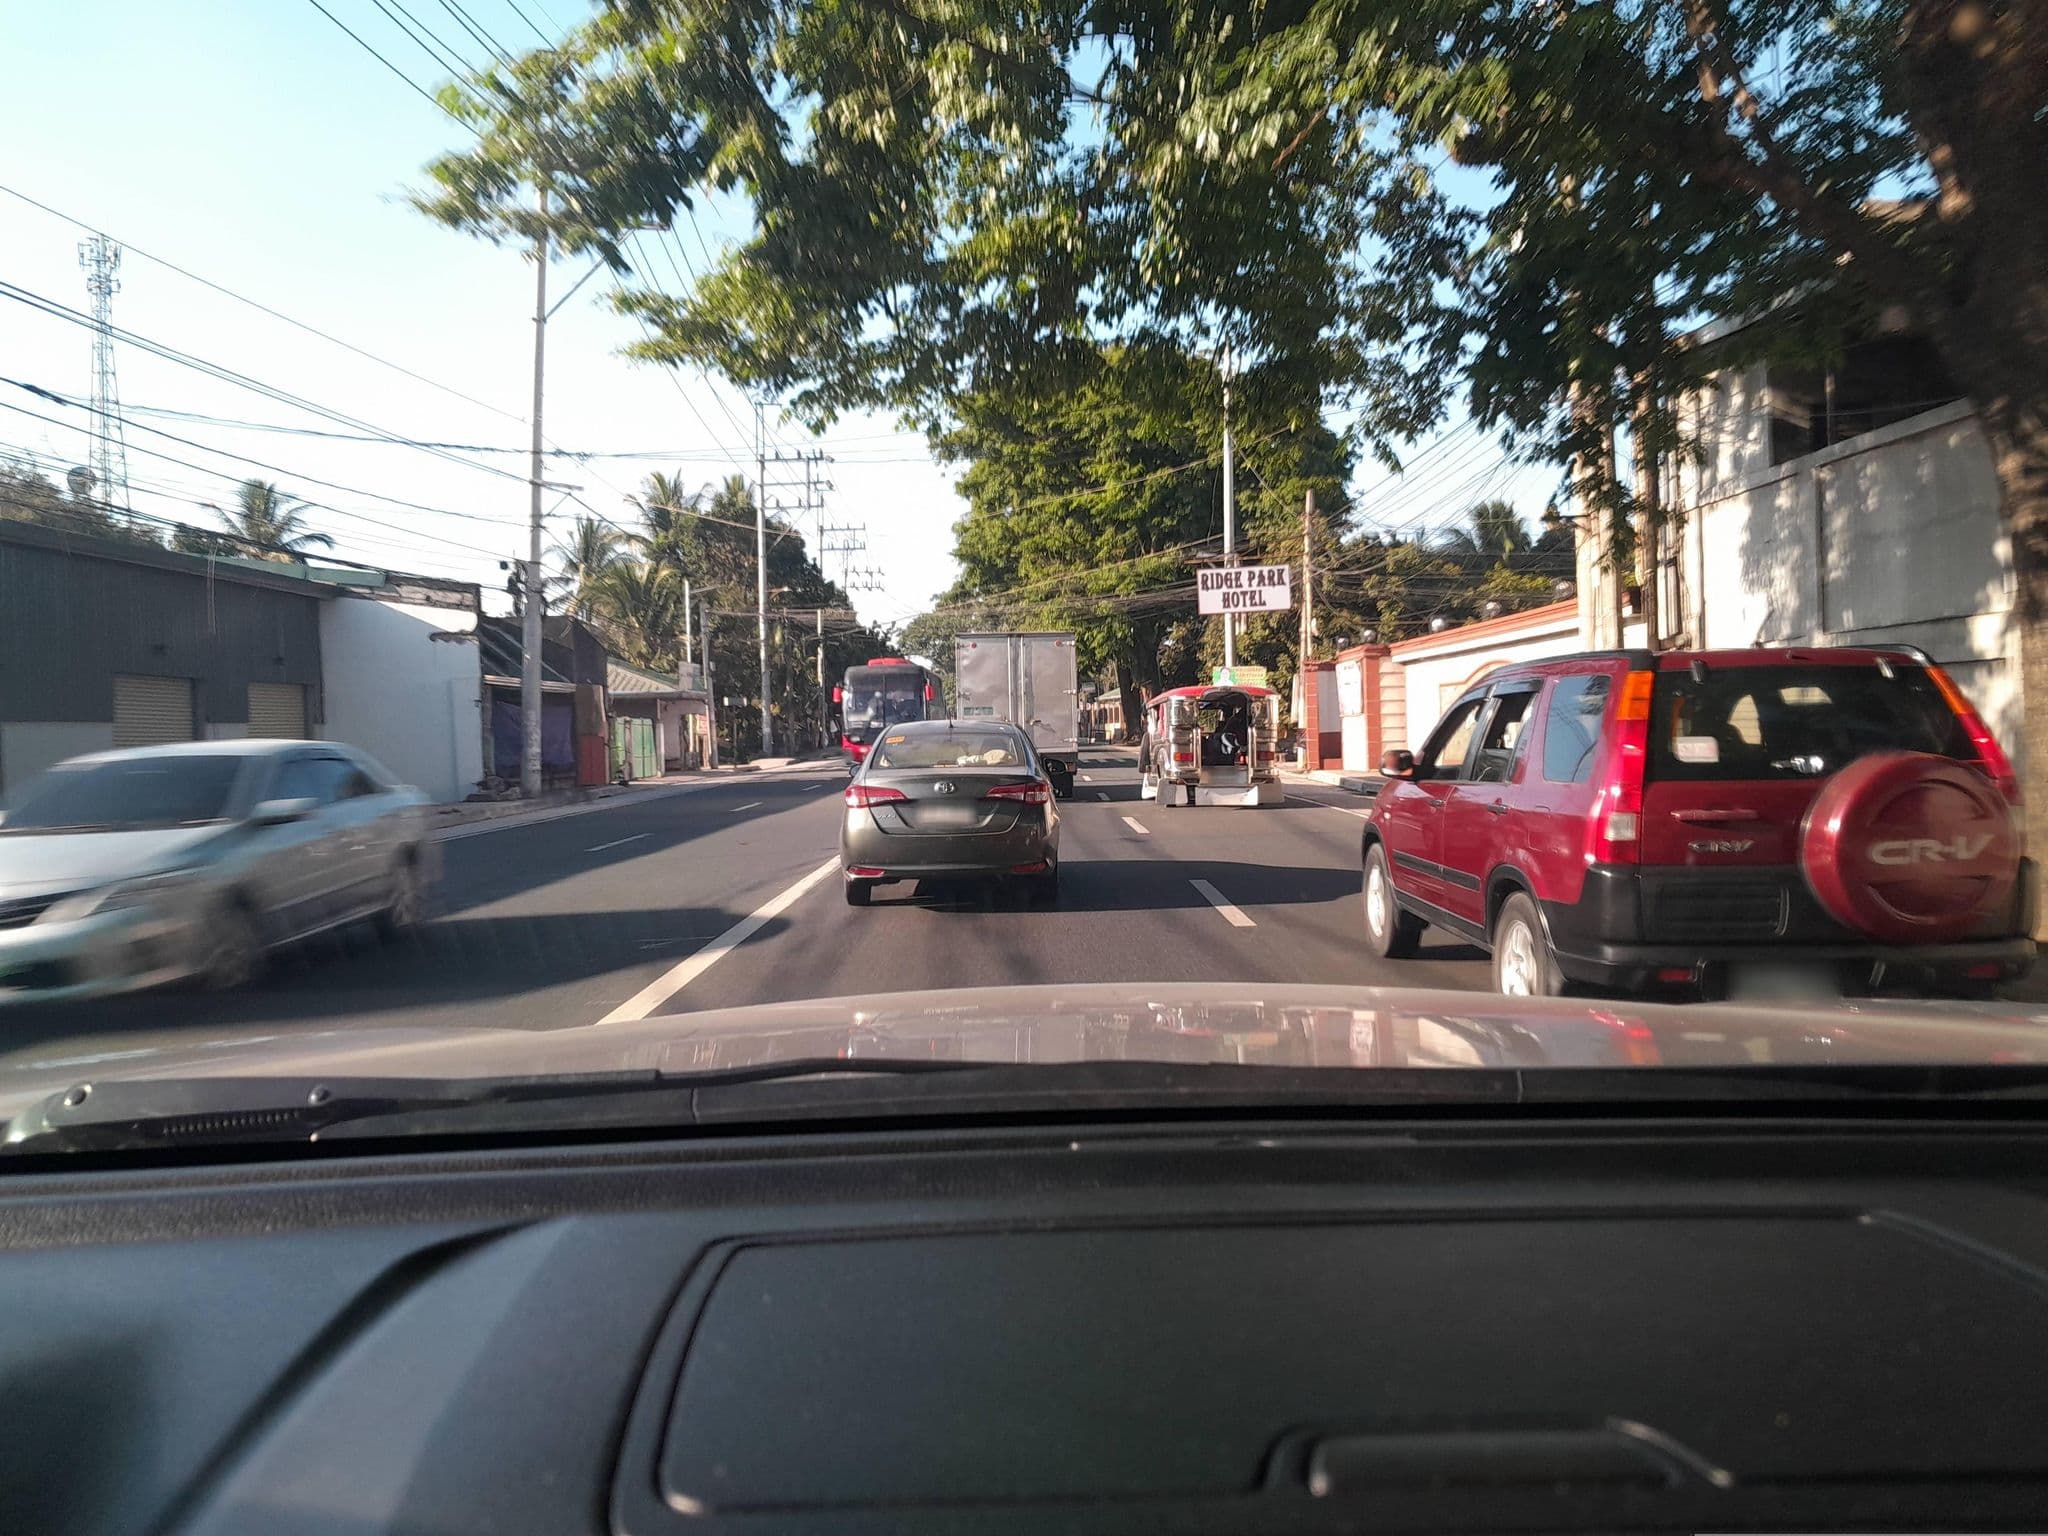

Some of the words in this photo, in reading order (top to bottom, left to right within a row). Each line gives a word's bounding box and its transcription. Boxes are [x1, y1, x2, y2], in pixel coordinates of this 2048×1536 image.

[1201, 571, 1243, 591] RIDGE
[1247, 568, 1286, 588] PARK
[1222, 589, 1267, 609] HOTEL
[1871, 832, 1995, 865] CR-V
